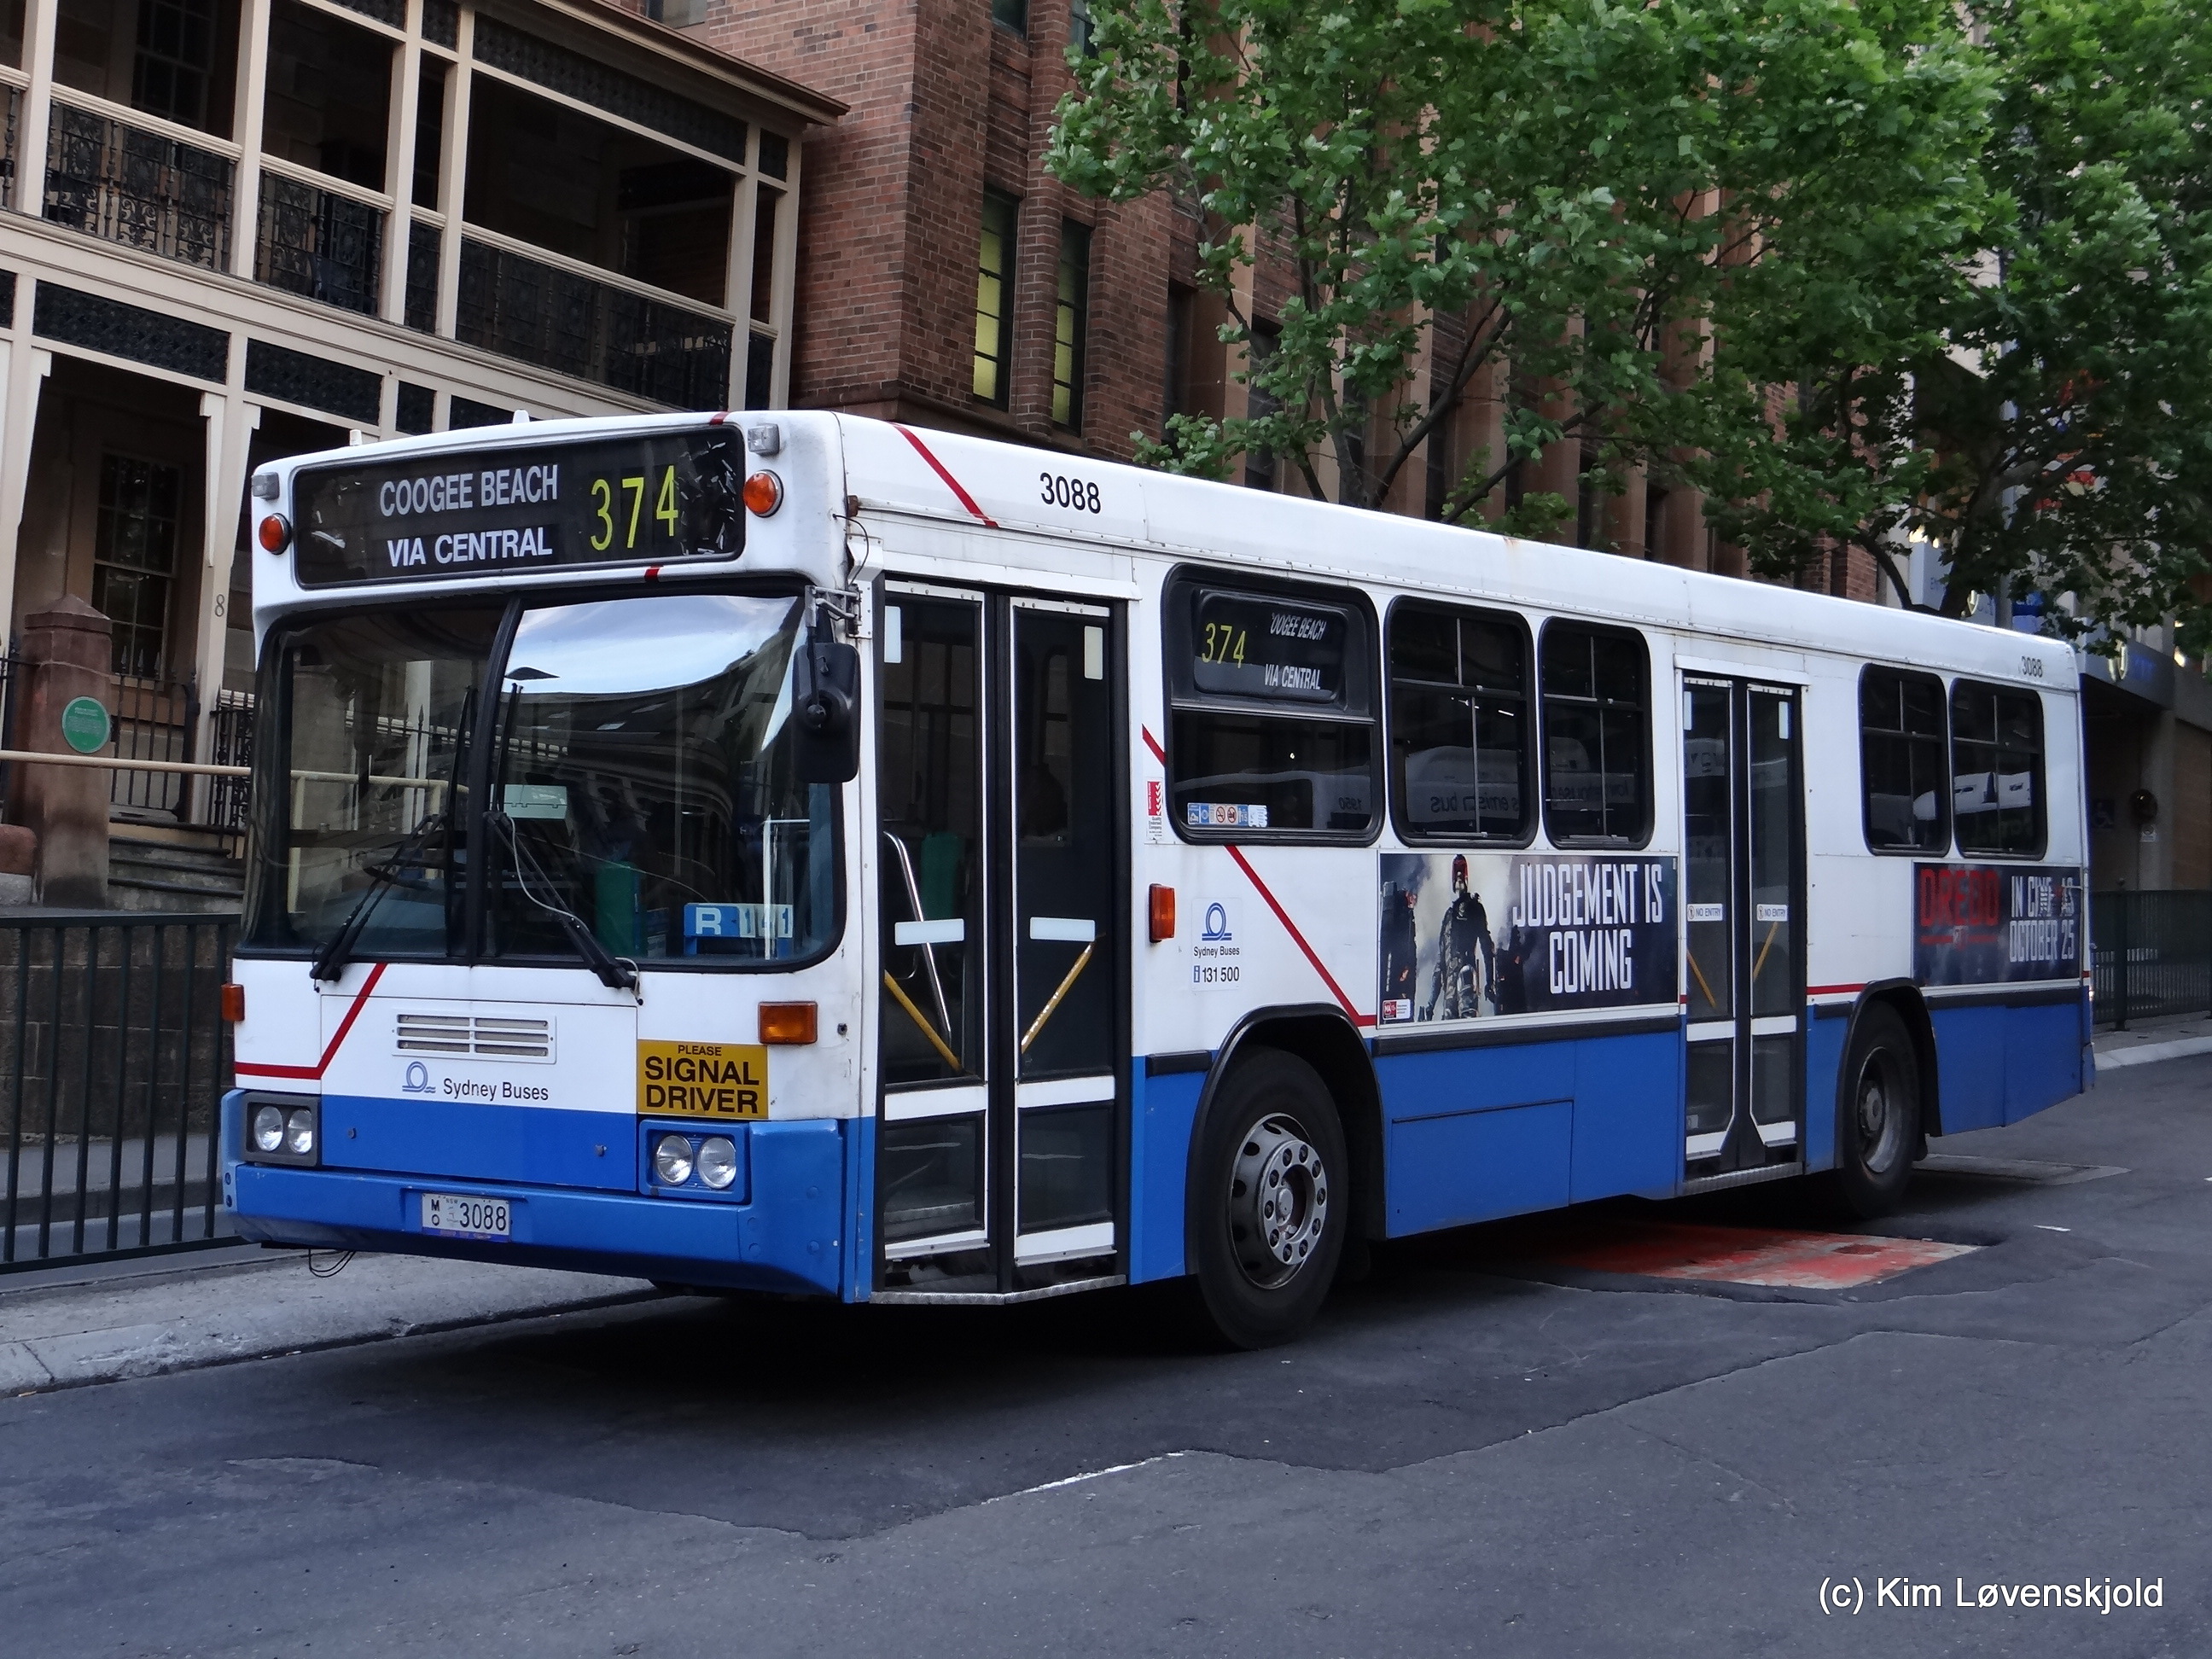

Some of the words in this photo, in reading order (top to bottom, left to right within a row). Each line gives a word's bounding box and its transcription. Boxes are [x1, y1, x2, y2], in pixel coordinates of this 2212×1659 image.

[380, 474, 474, 517] COOGEE
[481, 464, 558, 507] BEACH
[1039, 472, 1101, 514] 3088
[591, 464, 678, 551] 374
[387, 538, 426, 567] VIA
[434, 527, 553, 564] CENTRAL
[1297, 617, 1326, 640] BEACH
[1202, 623, 1246, 669] 374
[1265, 664, 1279, 687] VIA
[1282, 666, 1320, 690] CENTRAL
[2021, 655, 2043, 678] 3088
[1513, 864, 1638, 928] JUDGEMENT
[1644, 864, 1662, 923] IS
[1920, 869, 2000, 927] DREDD
[2011, 876, 2023, 917] IN
[696, 907, 722, 935] R
[1696, 907, 1703, 917] NO
[1705, 907, 1721, 917] ENTRY
[1765, 908, 1771, 917] NO
[1773, 908, 1786, 917] ENTRY
[1193, 946, 1218, 958] Sydney
[1220, 946, 1240, 956] Buses
[2010, 919, 2058, 963] OCTOBER
[2061, 919, 2075, 960] 25
[1202, 966, 1218, 982] 131
[1220, 966, 1240, 982] 500
[1550, 929, 1632, 994] COMING
[678, 1045, 722, 1057] PLEASE
[645, 1056, 760, 1086] SIGNAL
[443, 1078, 497, 1101] Sydney
[502, 1082, 549, 1100] Buses
[646, 1085, 758, 1114] DRIVER
[460, 1202, 506, 1231] 3088
